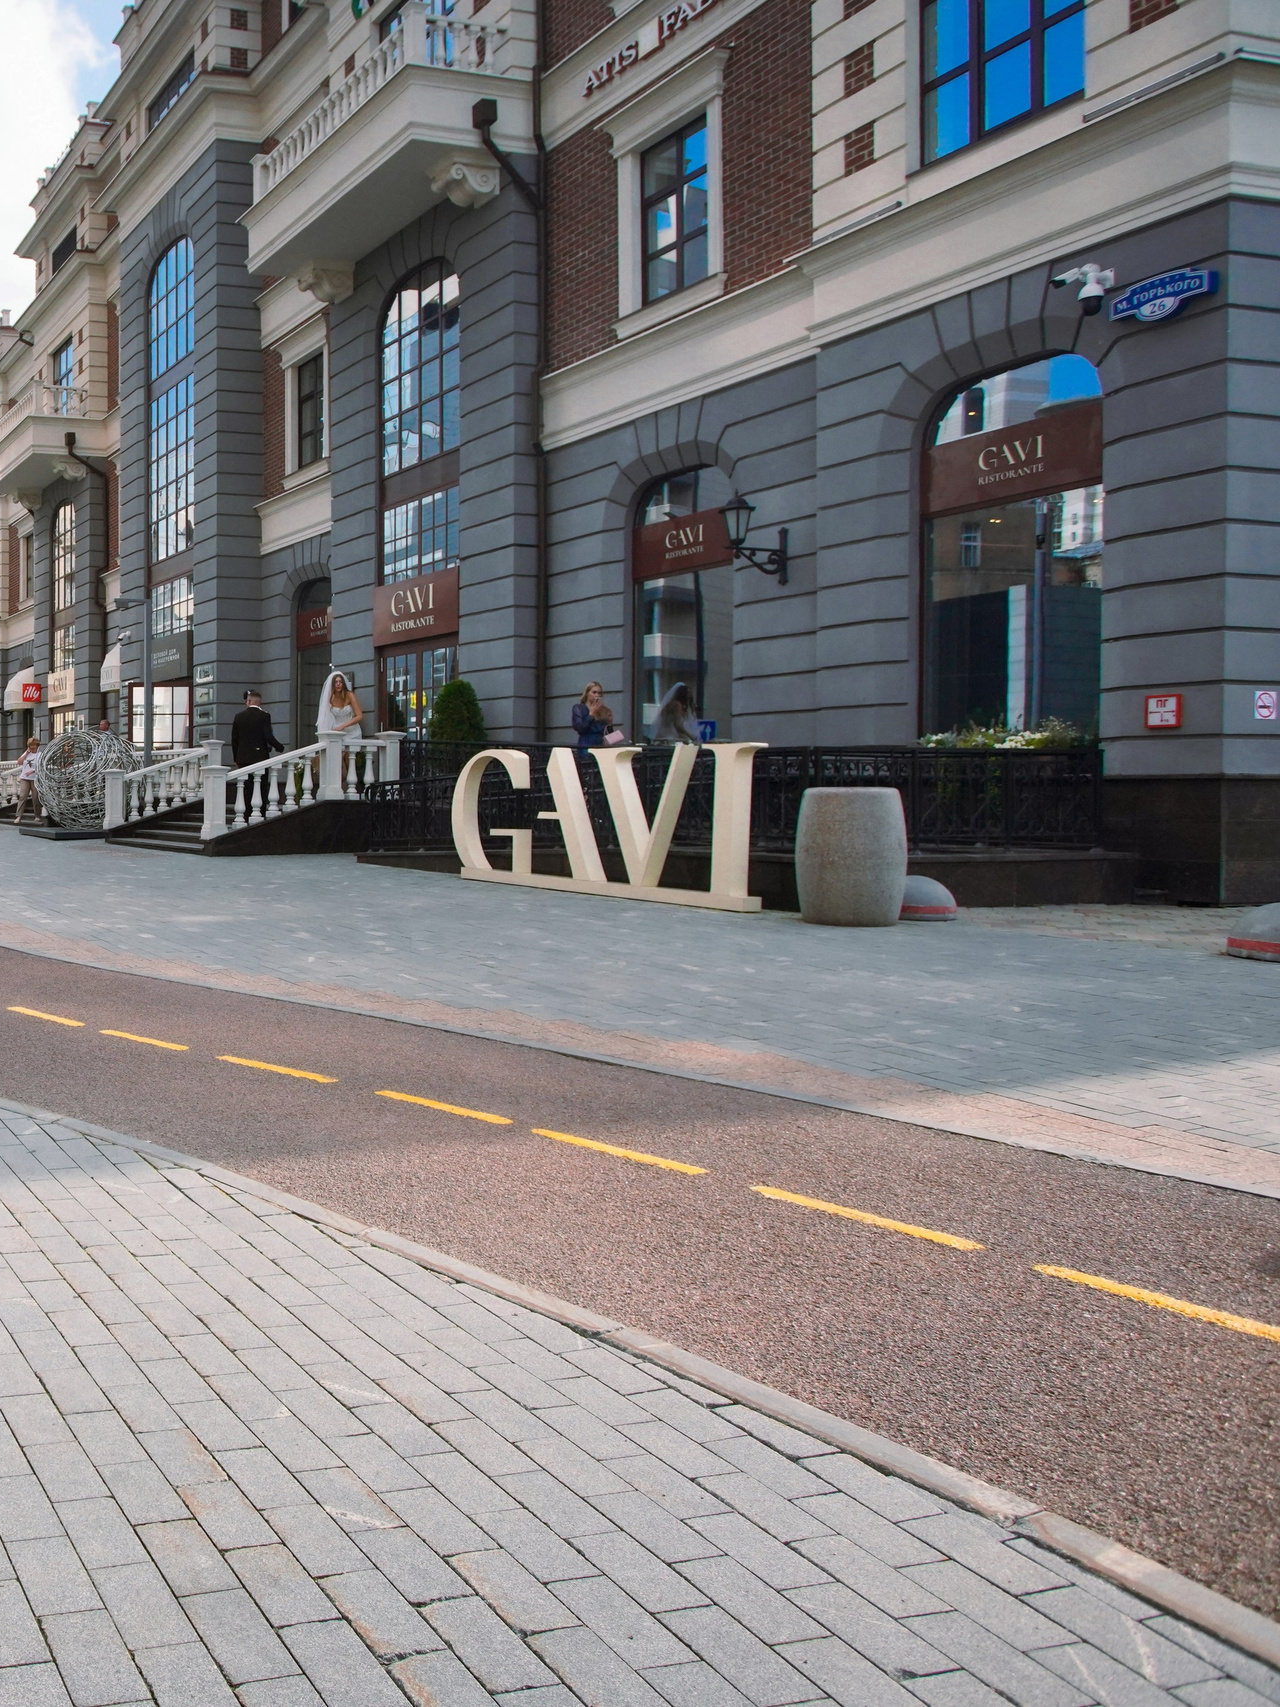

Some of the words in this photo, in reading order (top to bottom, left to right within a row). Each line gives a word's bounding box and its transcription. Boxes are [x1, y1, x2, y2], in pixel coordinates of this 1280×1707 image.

[582, 41, 638, 97] ATIS
[1116, 300, 1131, 313] М.
[1133, 278, 1200, 305] ГОРЬКОГО
[1149, 300, 1166, 315] 26
[978, 434, 1044, 471] GAVI
[977, 463, 1045, 486] RISTORANTE
[665, 523, 704, 549] GAVI
[390, 583, 435, 617] GAVI
[310, 615, 328, 630] GAVI
[390, 615, 435, 633] RISTORANTE
[23, 685, 40, 701] illy
[1156, 699, 1168, 708] ПГ
[451, 742, 769, 897] GAVI
